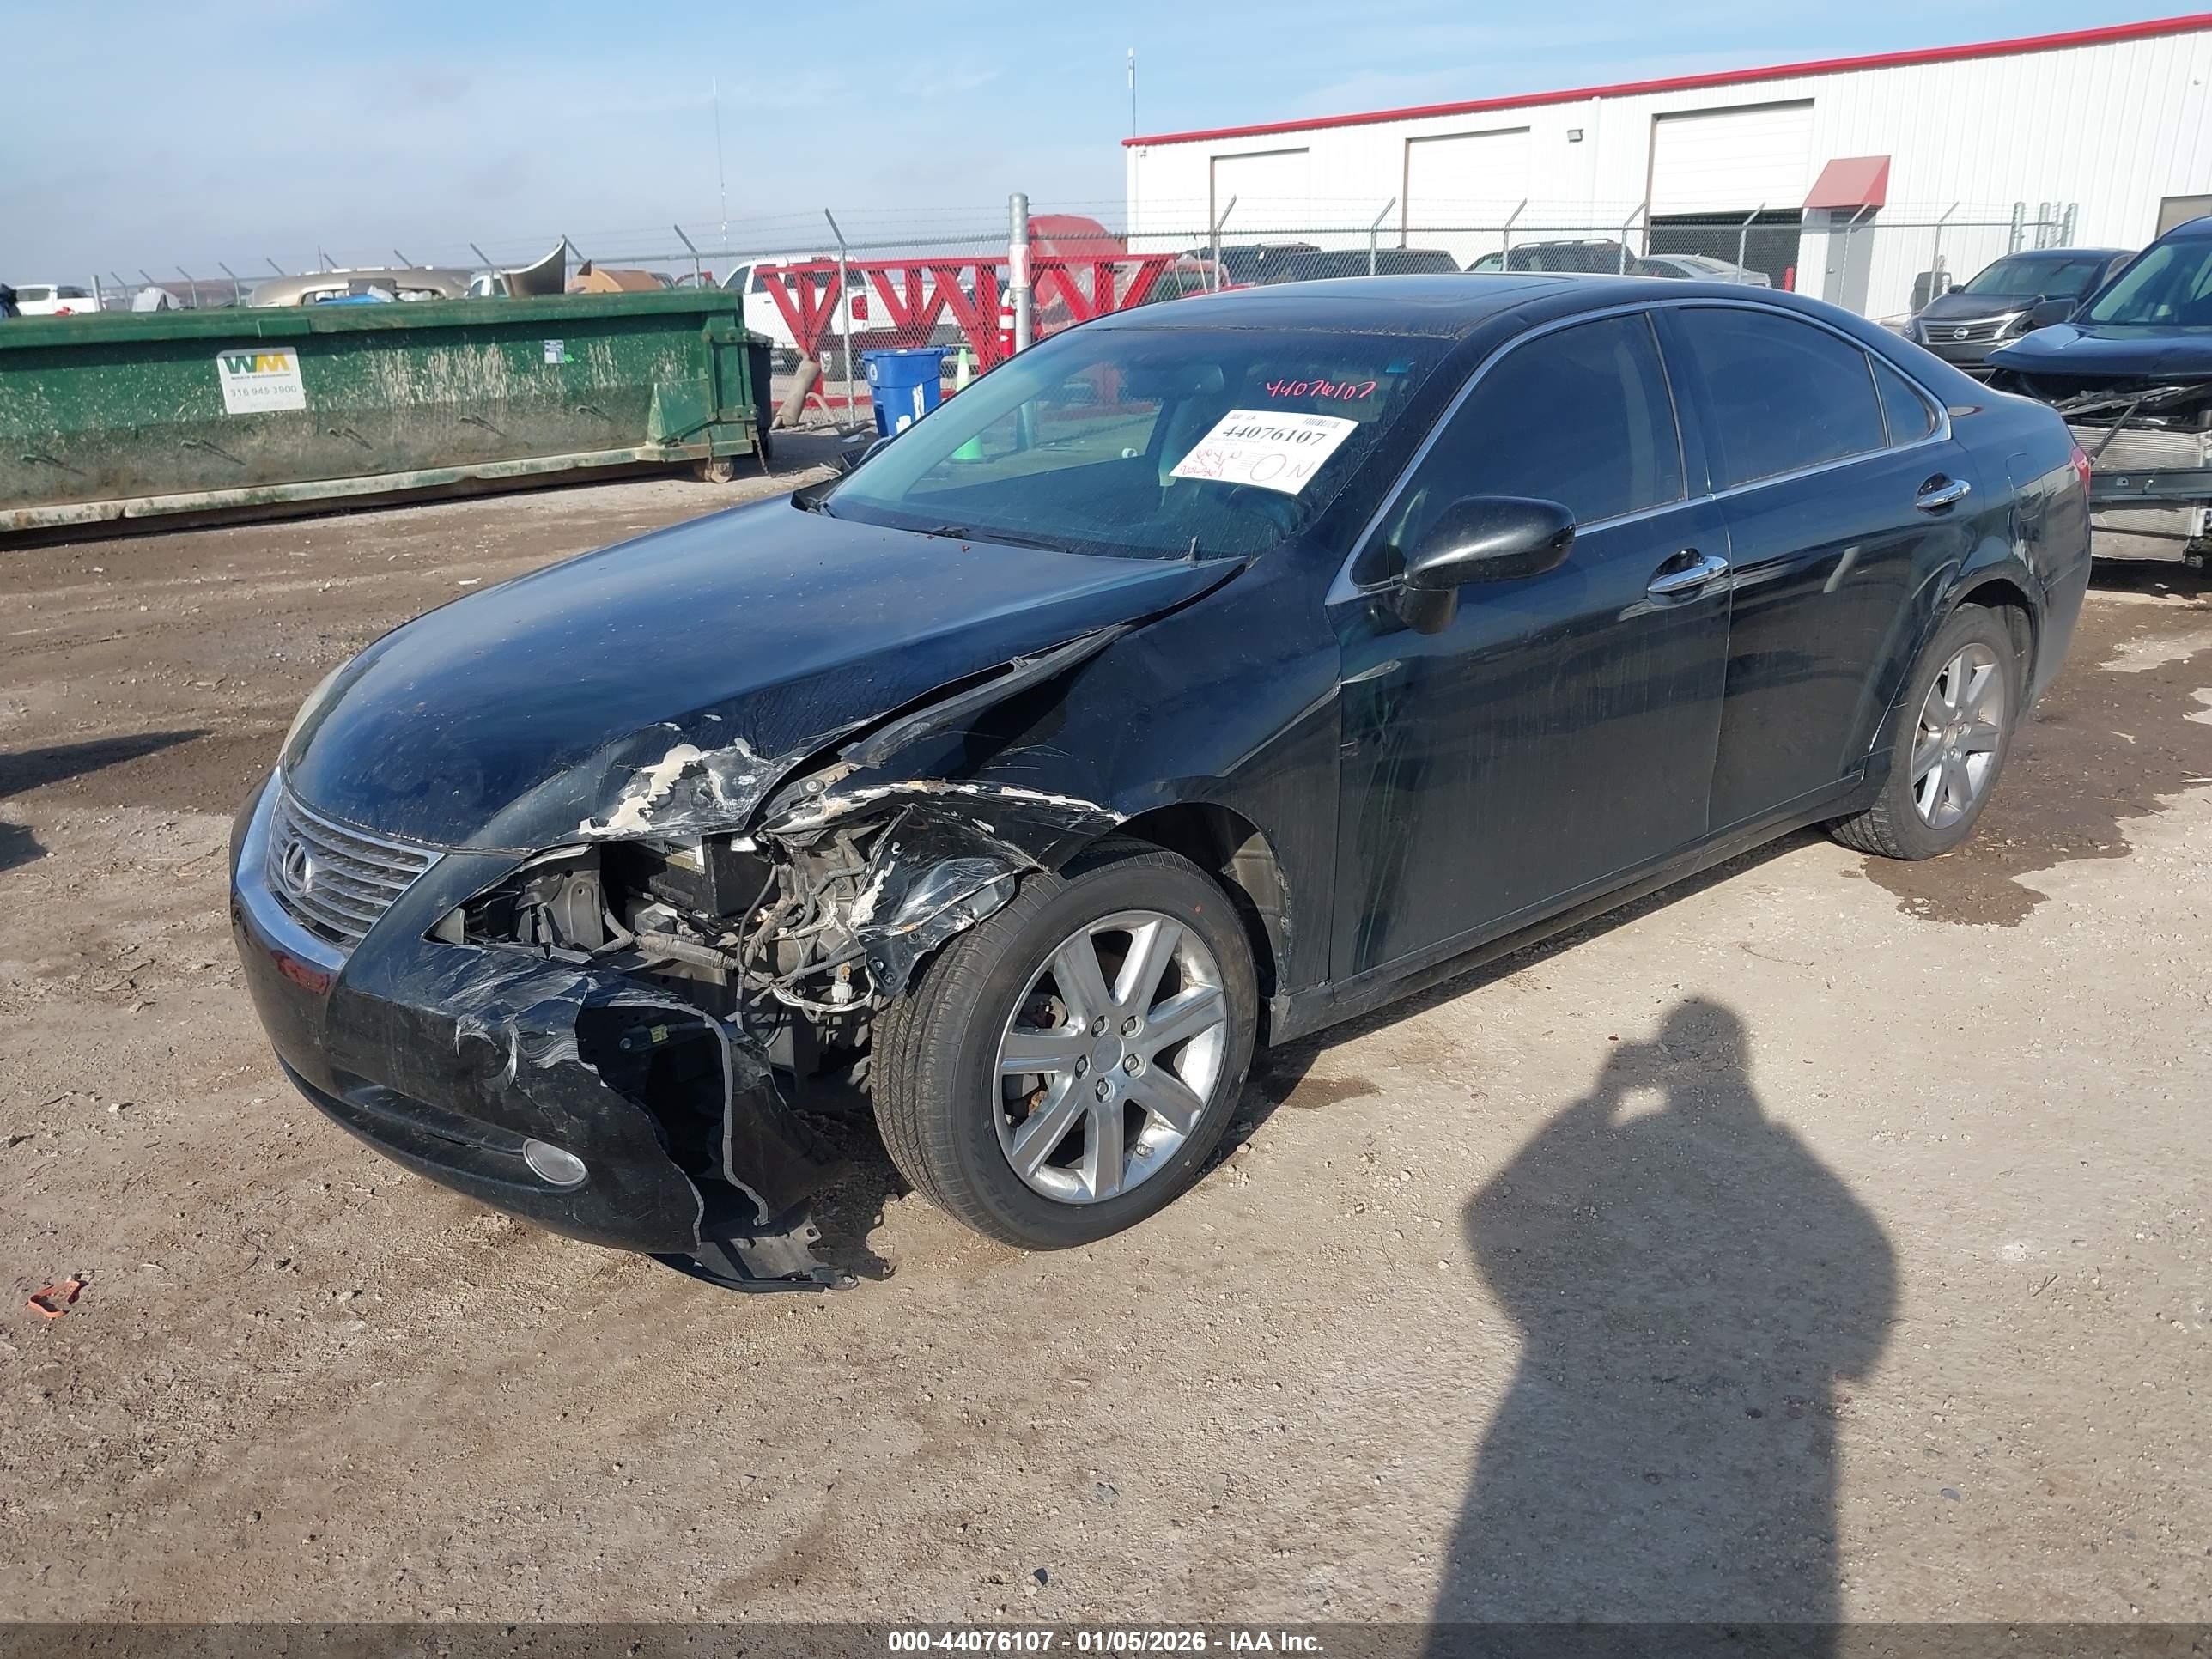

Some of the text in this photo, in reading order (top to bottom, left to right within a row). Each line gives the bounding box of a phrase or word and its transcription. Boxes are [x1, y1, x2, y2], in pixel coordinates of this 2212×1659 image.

[223, 355, 289, 374] WM
[230, 385, 297, 398] 316 945 3900
[1266, 378, 1377, 401] 44076107
[1223, 424, 1328, 447] 44076107
